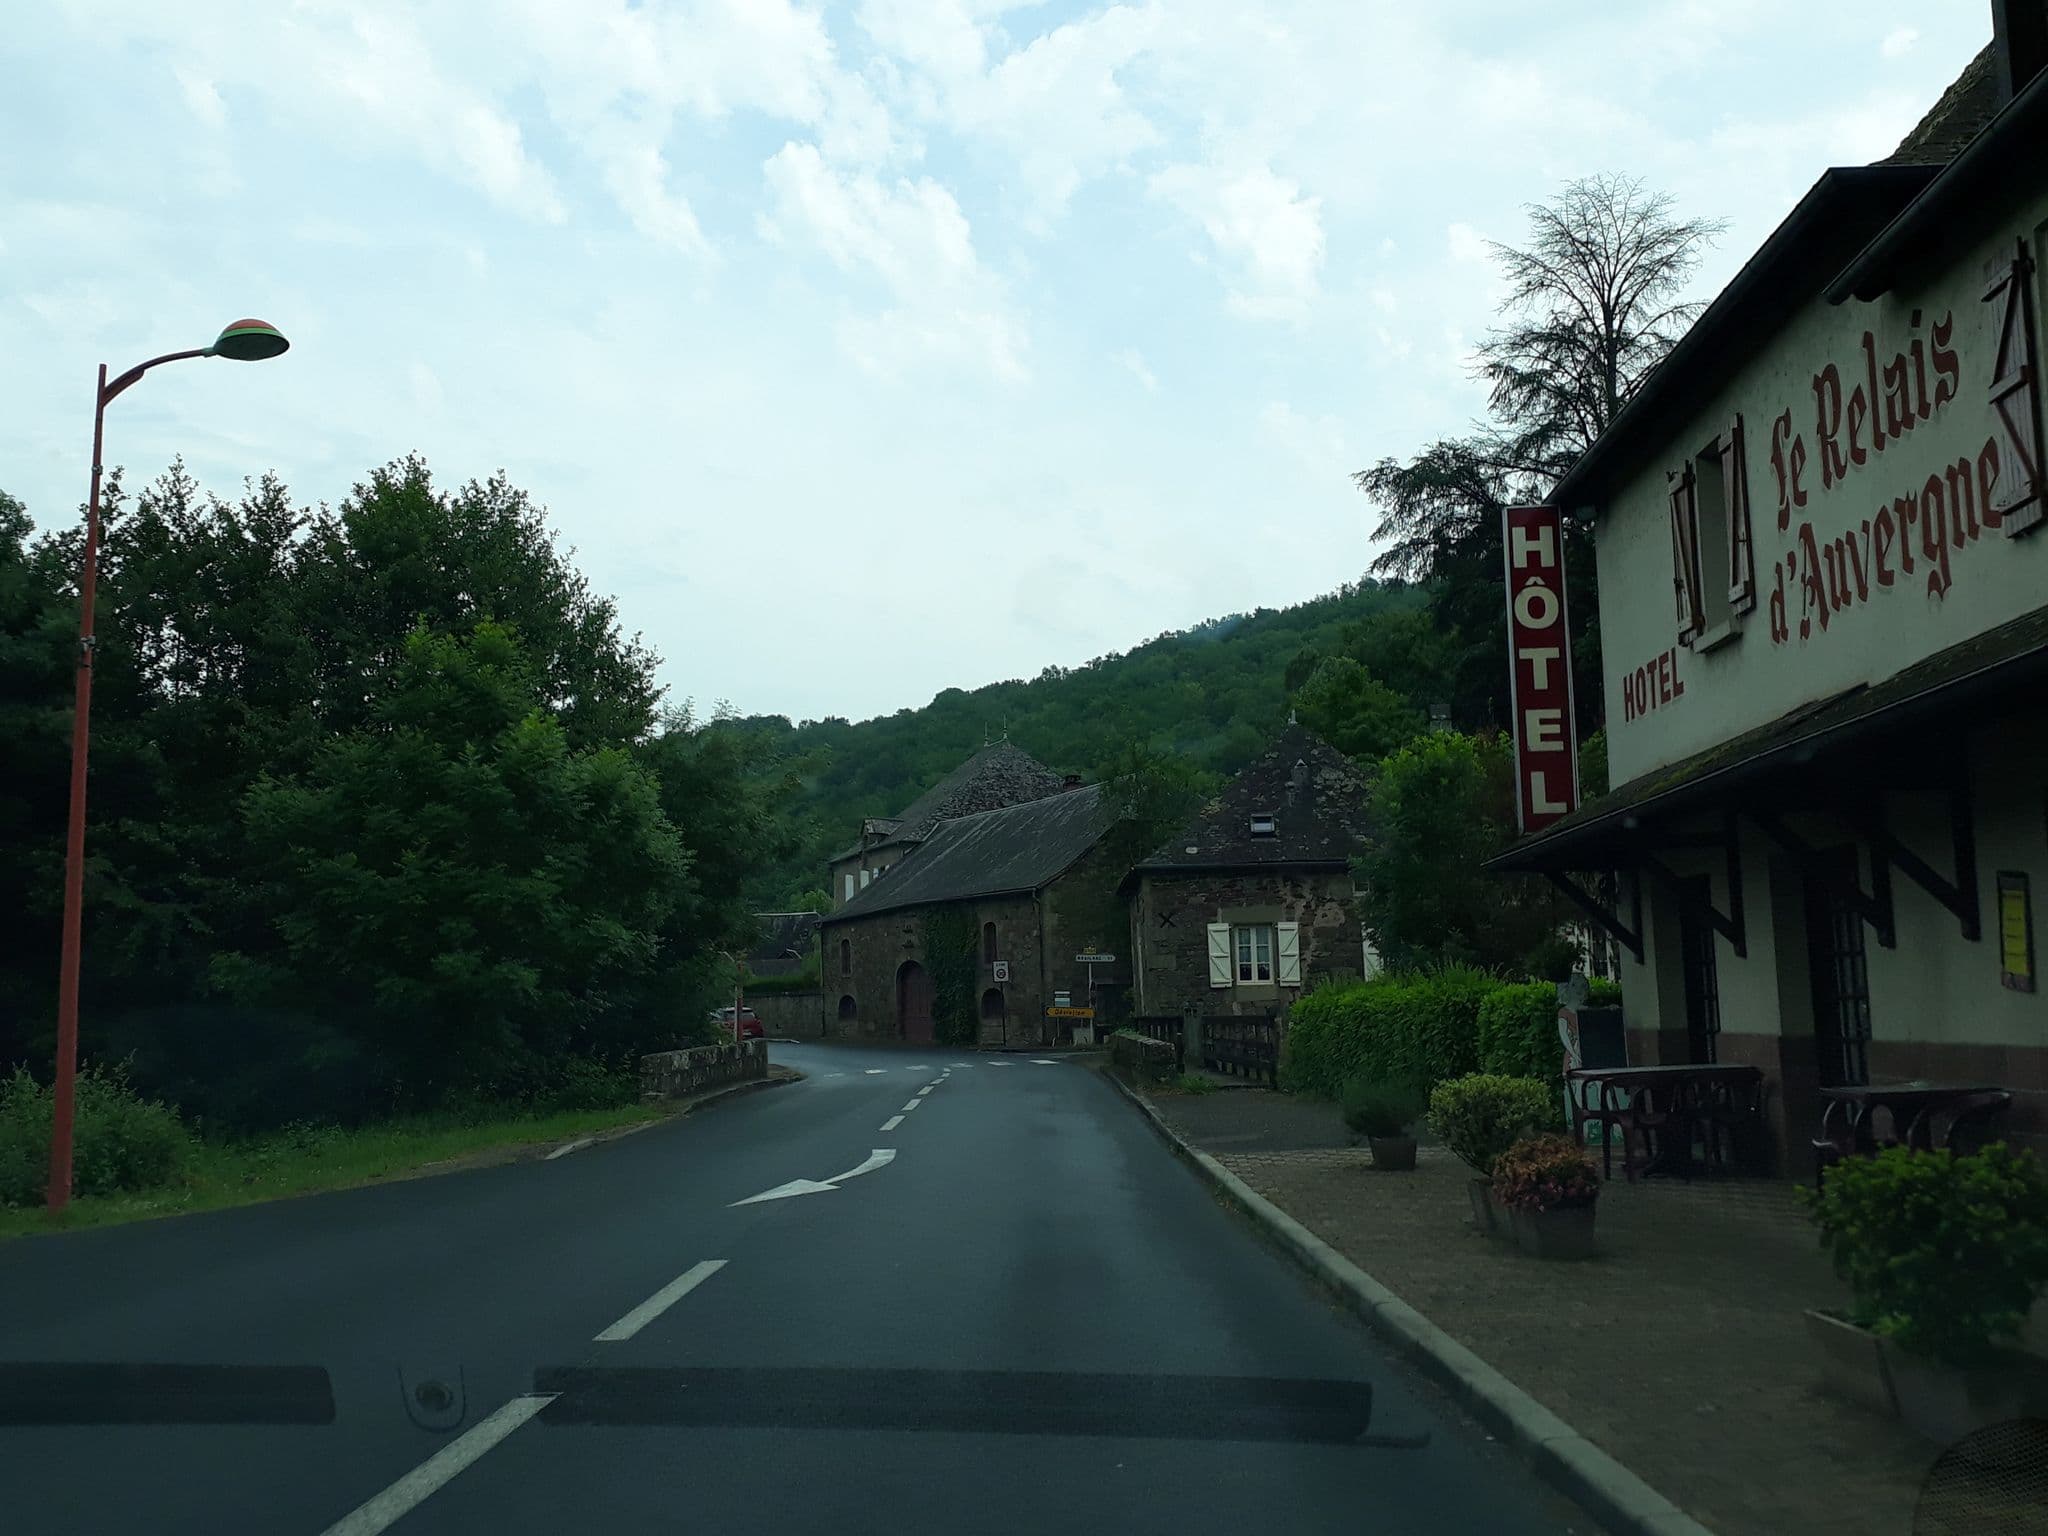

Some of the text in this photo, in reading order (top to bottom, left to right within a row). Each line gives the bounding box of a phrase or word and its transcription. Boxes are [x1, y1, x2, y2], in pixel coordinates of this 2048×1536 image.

[1771, 310, 1960, 532] Le Relais
[1770, 436, 2003, 644] d'Auvergne
[1511, 525, 1567, 815] HÔTEL
[1623, 647, 1684, 722] HOTEL
